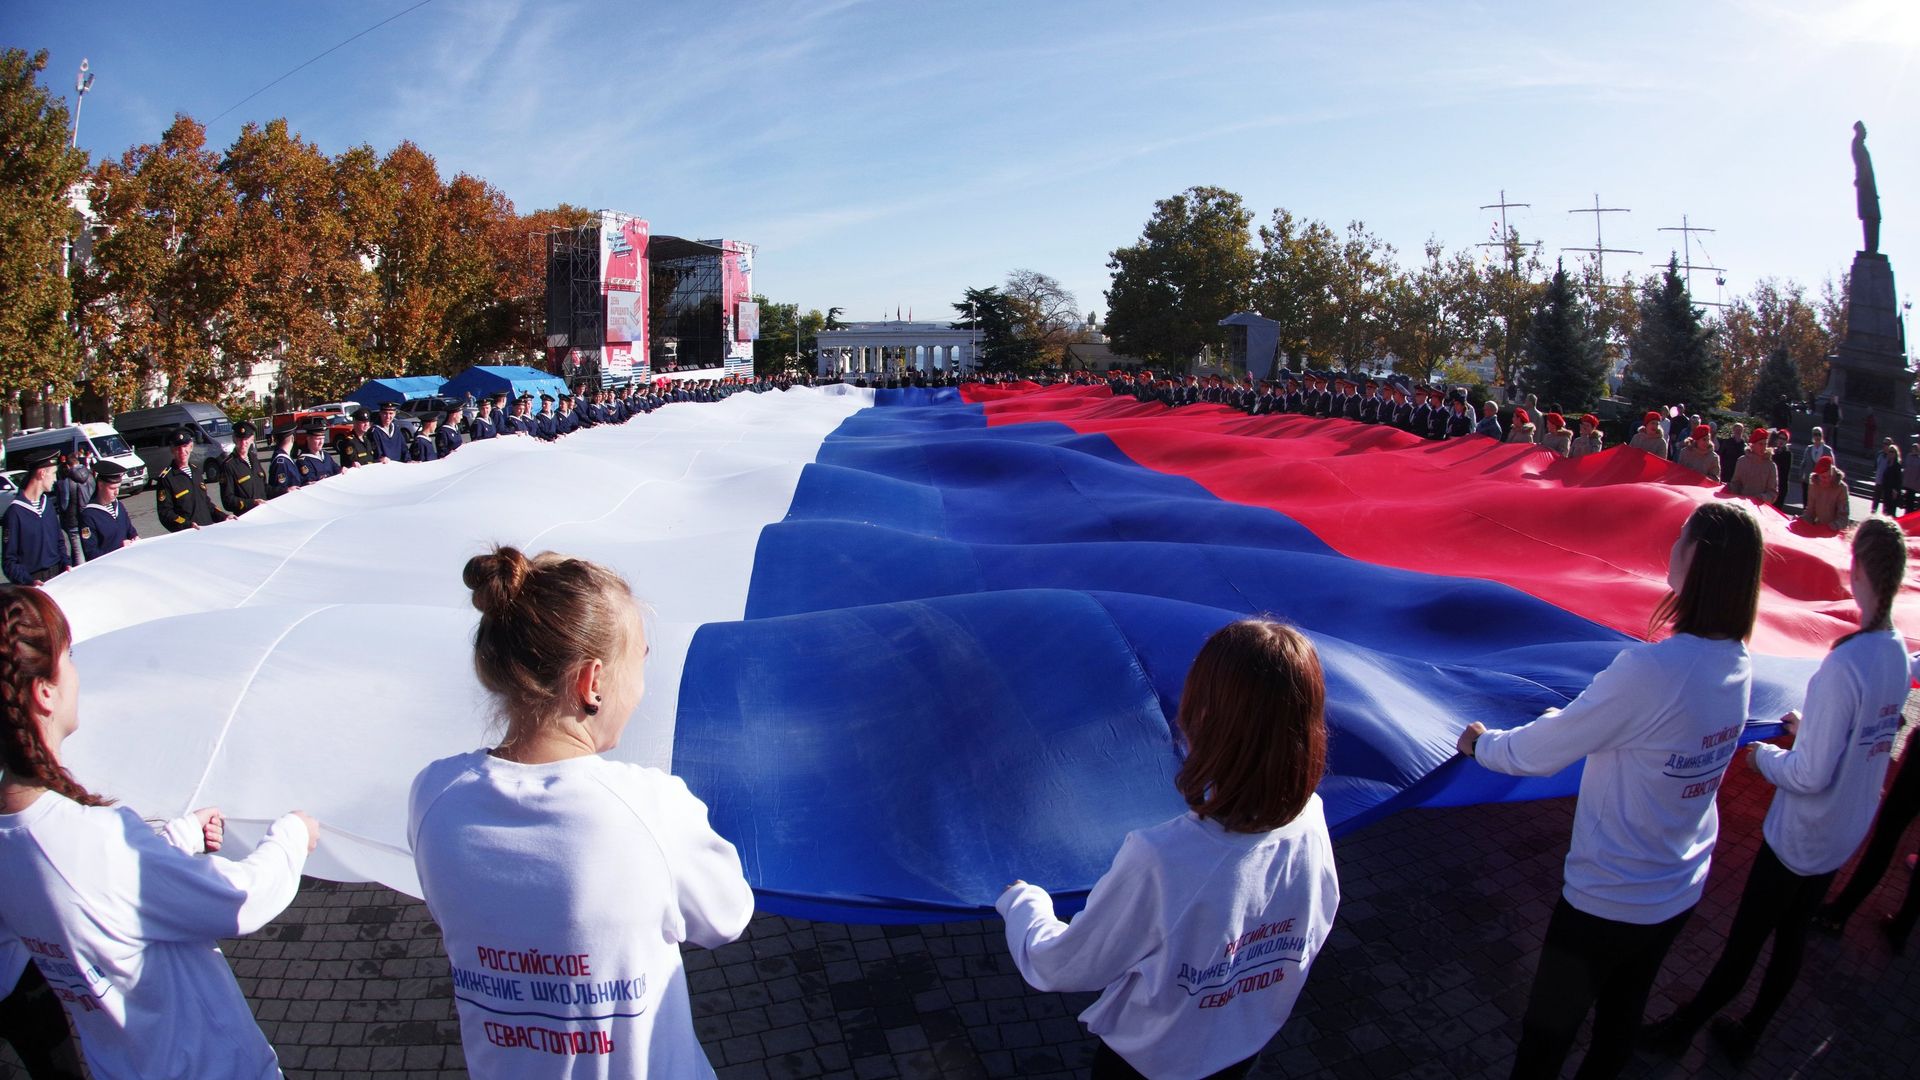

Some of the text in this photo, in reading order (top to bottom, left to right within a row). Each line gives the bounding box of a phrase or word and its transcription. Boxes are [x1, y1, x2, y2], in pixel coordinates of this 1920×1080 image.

[1224, 918, 1296, 958] РОССИЙСКОЕ
[477, 946, 591, 977] РОССИЙСКОЕ
[1177, 934, 1308, 985] ДВИЖЕНИЕ ШКОЛЬНИ
[452, 966, 647, 1005] ВИЖЕНИЕ ШКОЛЬНИКОВ
[1199, 967, 1285, 1009] СЕВАСТОПОЛЬ
[483, 1021, 615, 1056] СЕВАСТОПОЛЬ
